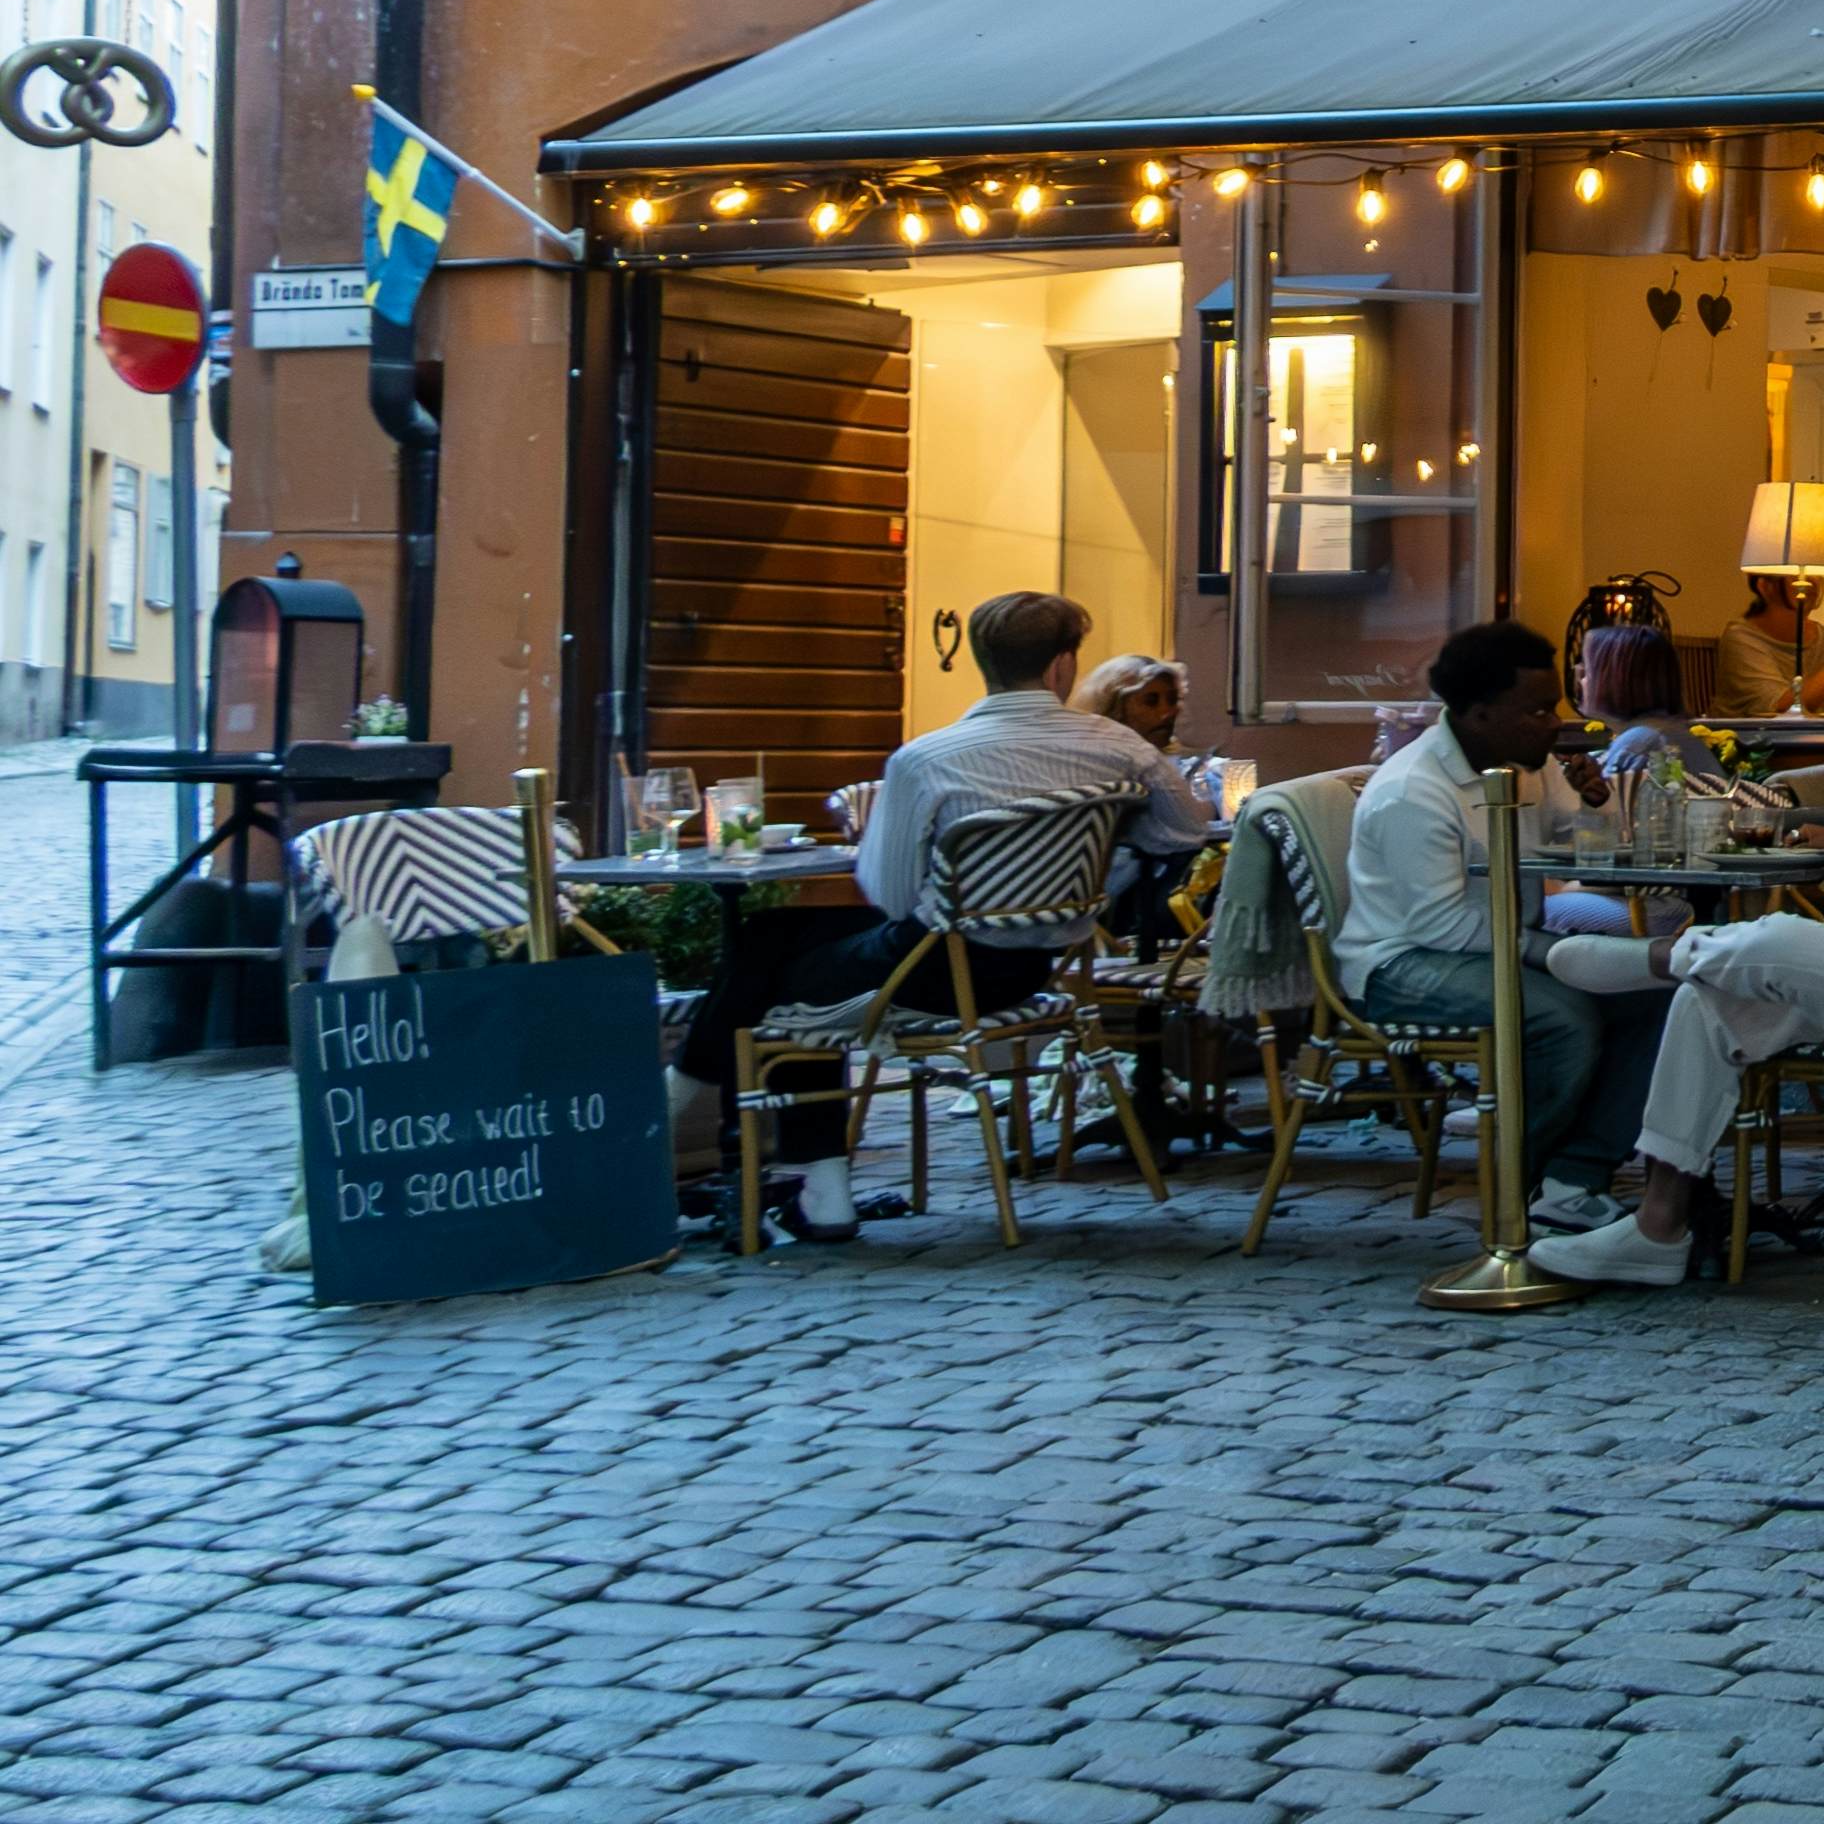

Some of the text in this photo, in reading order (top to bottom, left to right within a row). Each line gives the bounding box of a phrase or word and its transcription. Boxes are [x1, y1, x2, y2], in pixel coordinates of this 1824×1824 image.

[330, 278, 364, 299] Tom
[315, 982, 430, 1072] Hello!
[325, 1086, 606, 1157] Please wait to
[337, 1143, 544, 1222] be seated!
